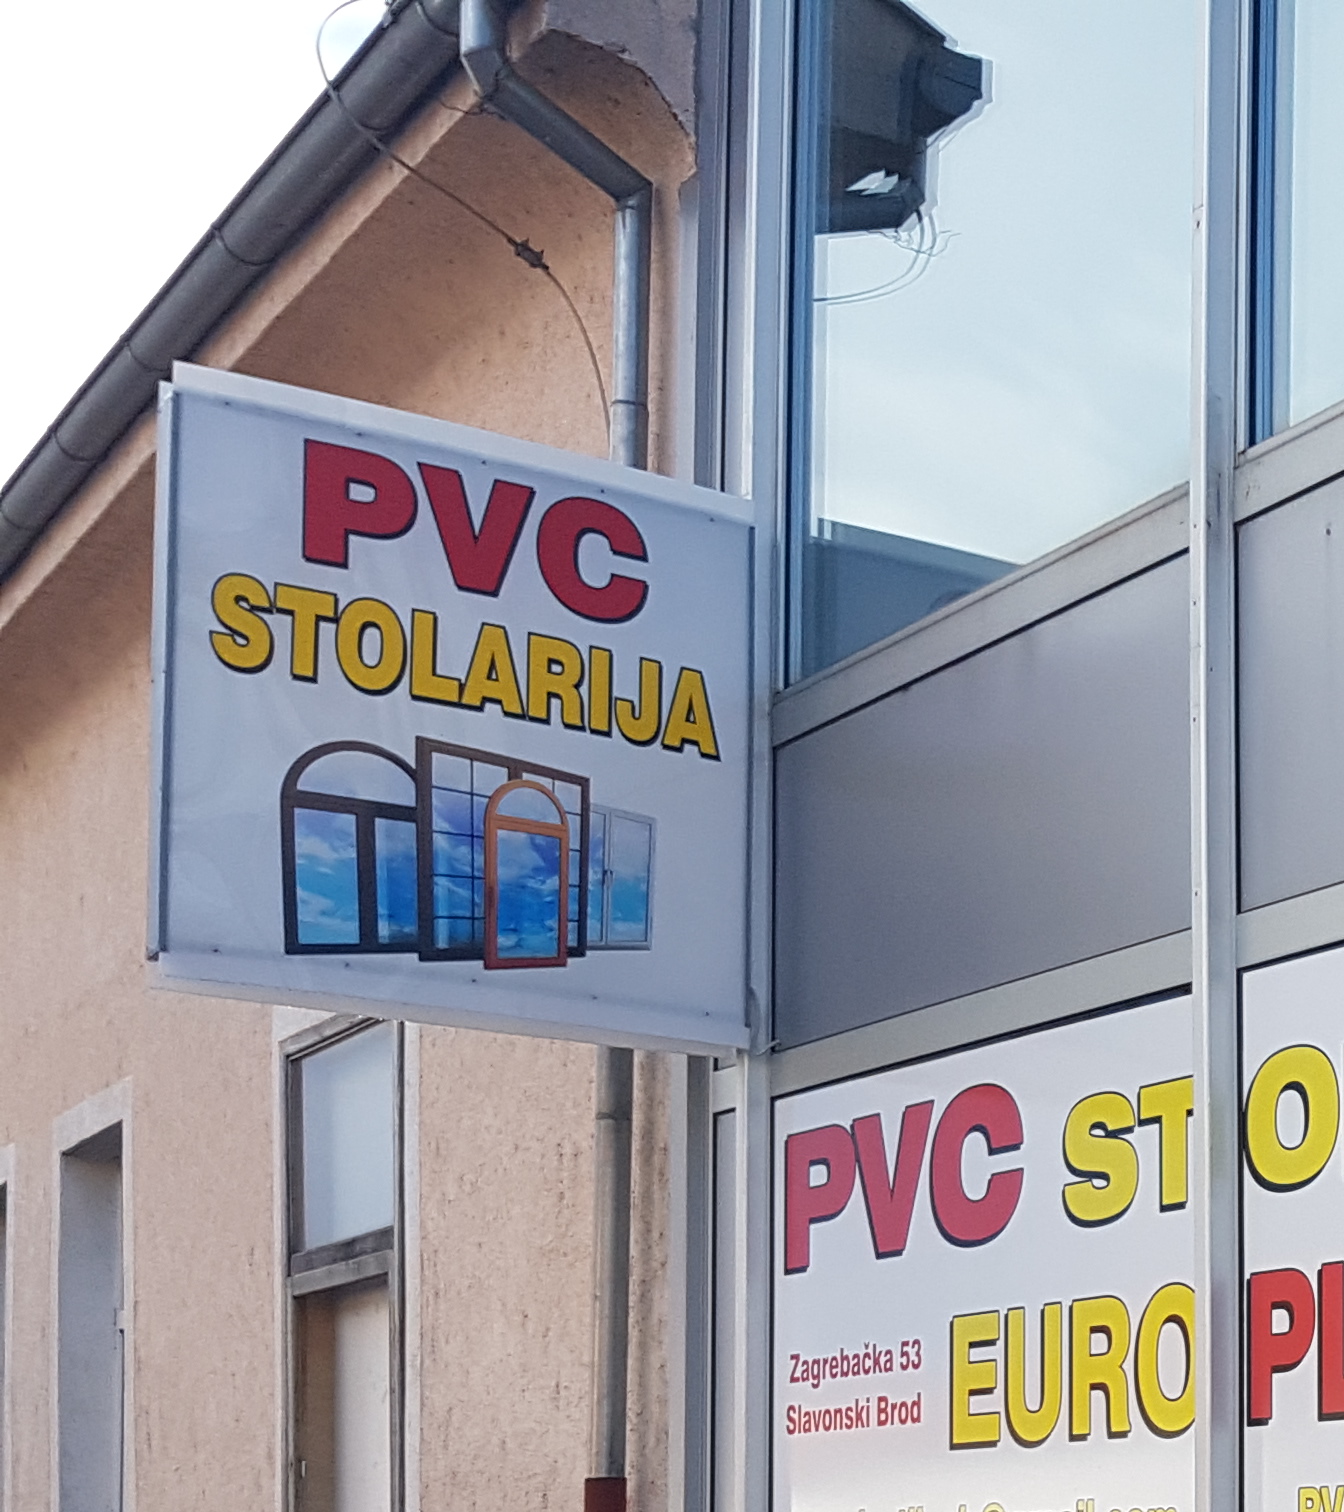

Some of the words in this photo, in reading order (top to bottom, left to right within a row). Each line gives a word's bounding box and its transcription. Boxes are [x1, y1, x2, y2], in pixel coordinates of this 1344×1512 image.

[303, 438, 650, 623] PVC
[209, 572, 722, 761] STOLARIJA
[784, 1082, 1024, 1275] PVC
[786, 1397, 871, 1436] Slavonski
[876, 1391, 922, 1427] Brod
[789, 1342, 894, 1389] Zagrebačka
[900, 1339, 923, 1371] 53
[949, 1282, 1196, 1451] EURO
